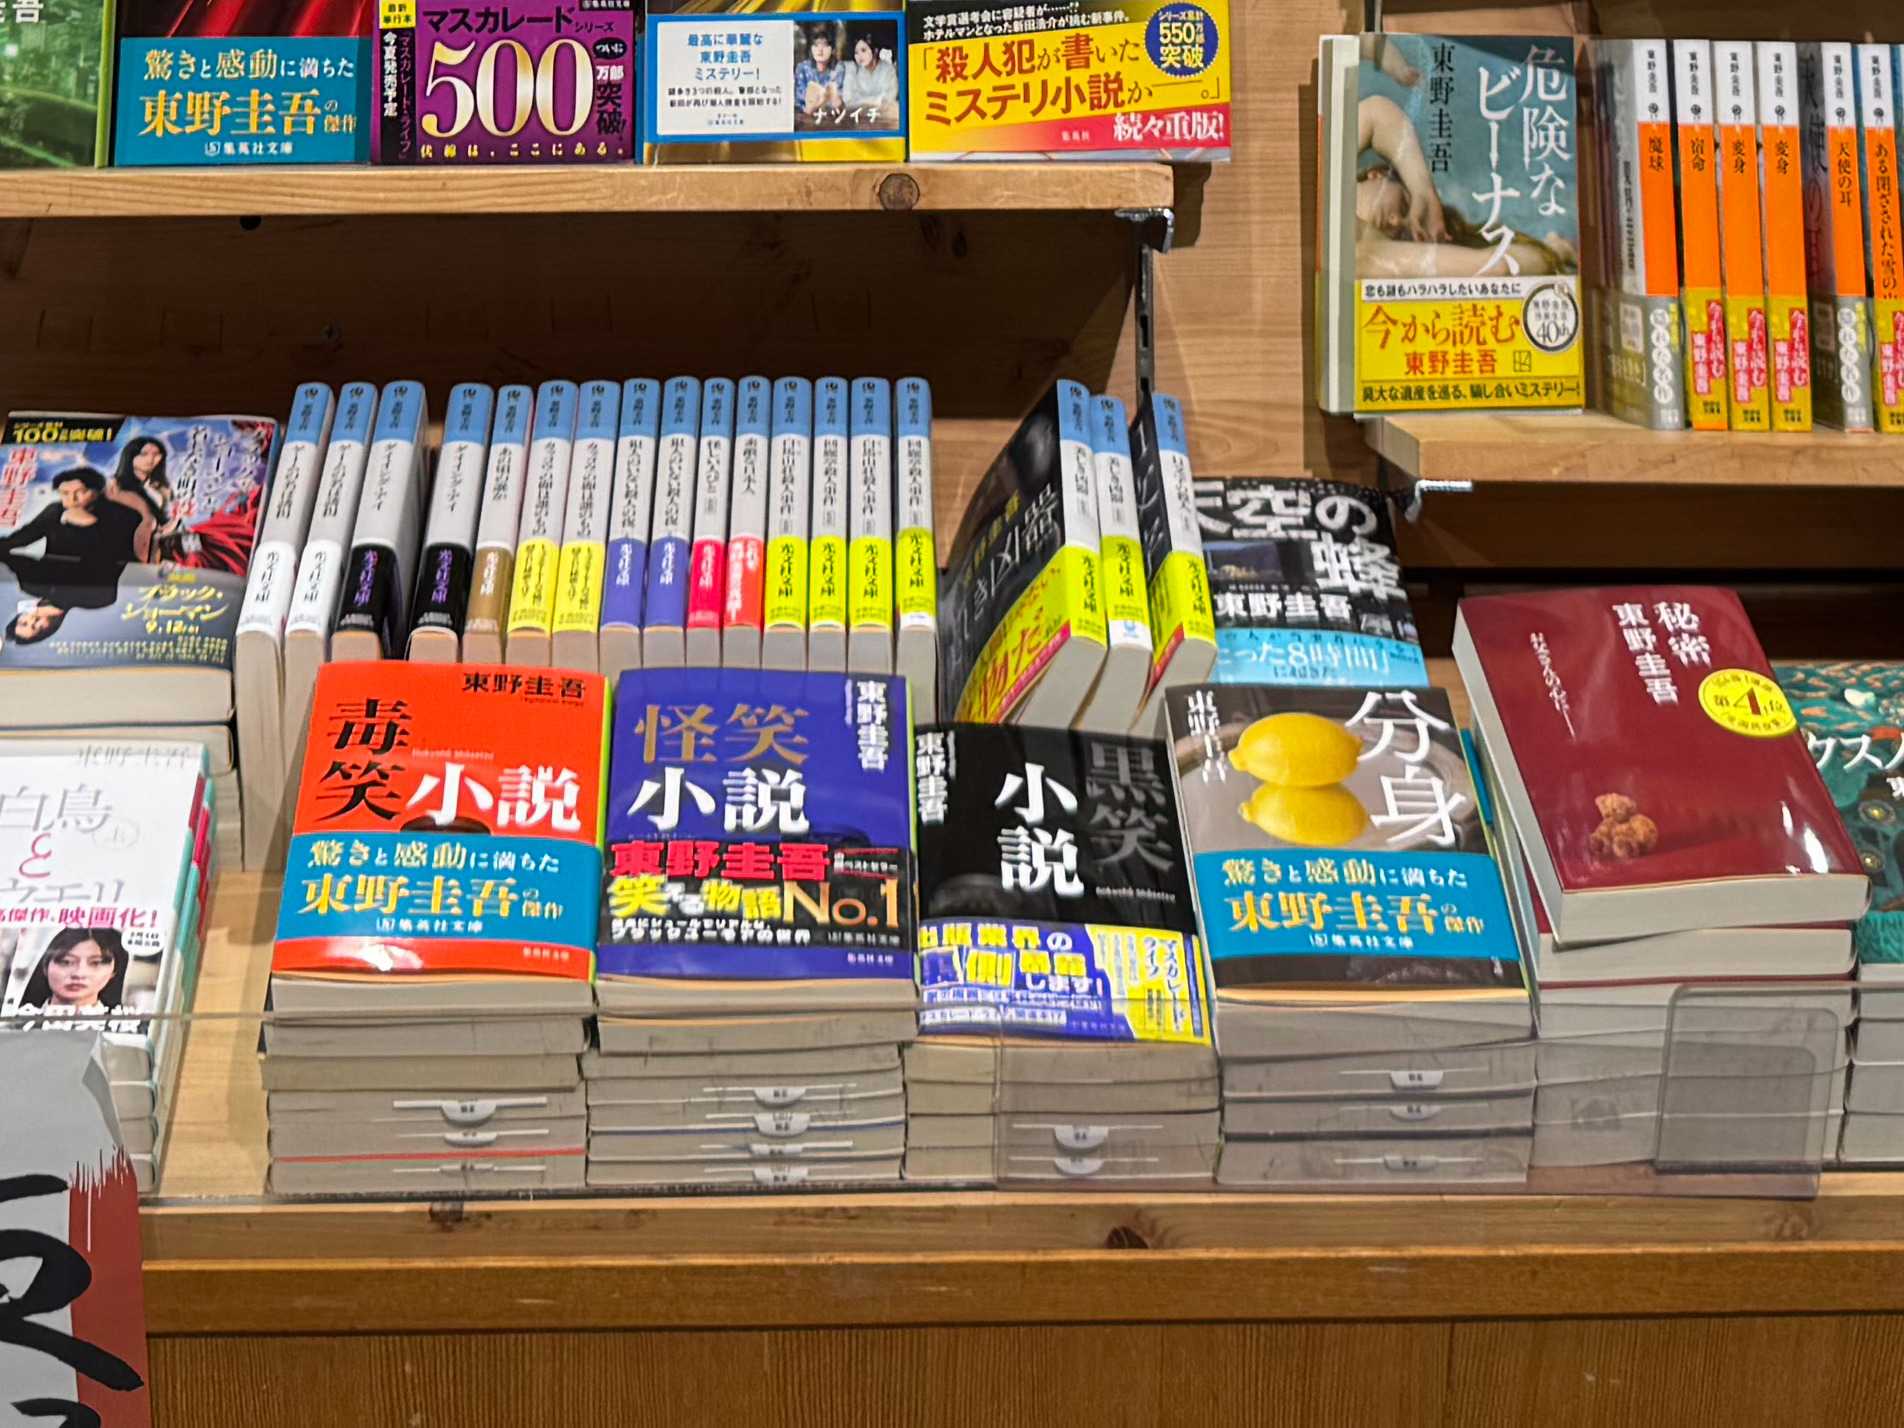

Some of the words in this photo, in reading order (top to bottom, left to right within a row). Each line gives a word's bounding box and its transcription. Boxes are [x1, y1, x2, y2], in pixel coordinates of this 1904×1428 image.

[421, 36, 591, 136] 500
[812, 107, 882, 126] ナツイチ
[1111, 111, 1224, 141] 続々重版!
[1518, 44, 1572, 216] 危険な
[1471, 65, 1522, 277] ビーナス
[1364, 304, 1524, 349] 今から読む
[634, 702, 810, 764] 怪笑
[407, 762, 583, 833] 小説
[628, 766, 810, 834] 小説
[1346, 689, 1469, 849] 分身
[1221, 851, 1468, 892] 驚きと感動に満ちた
